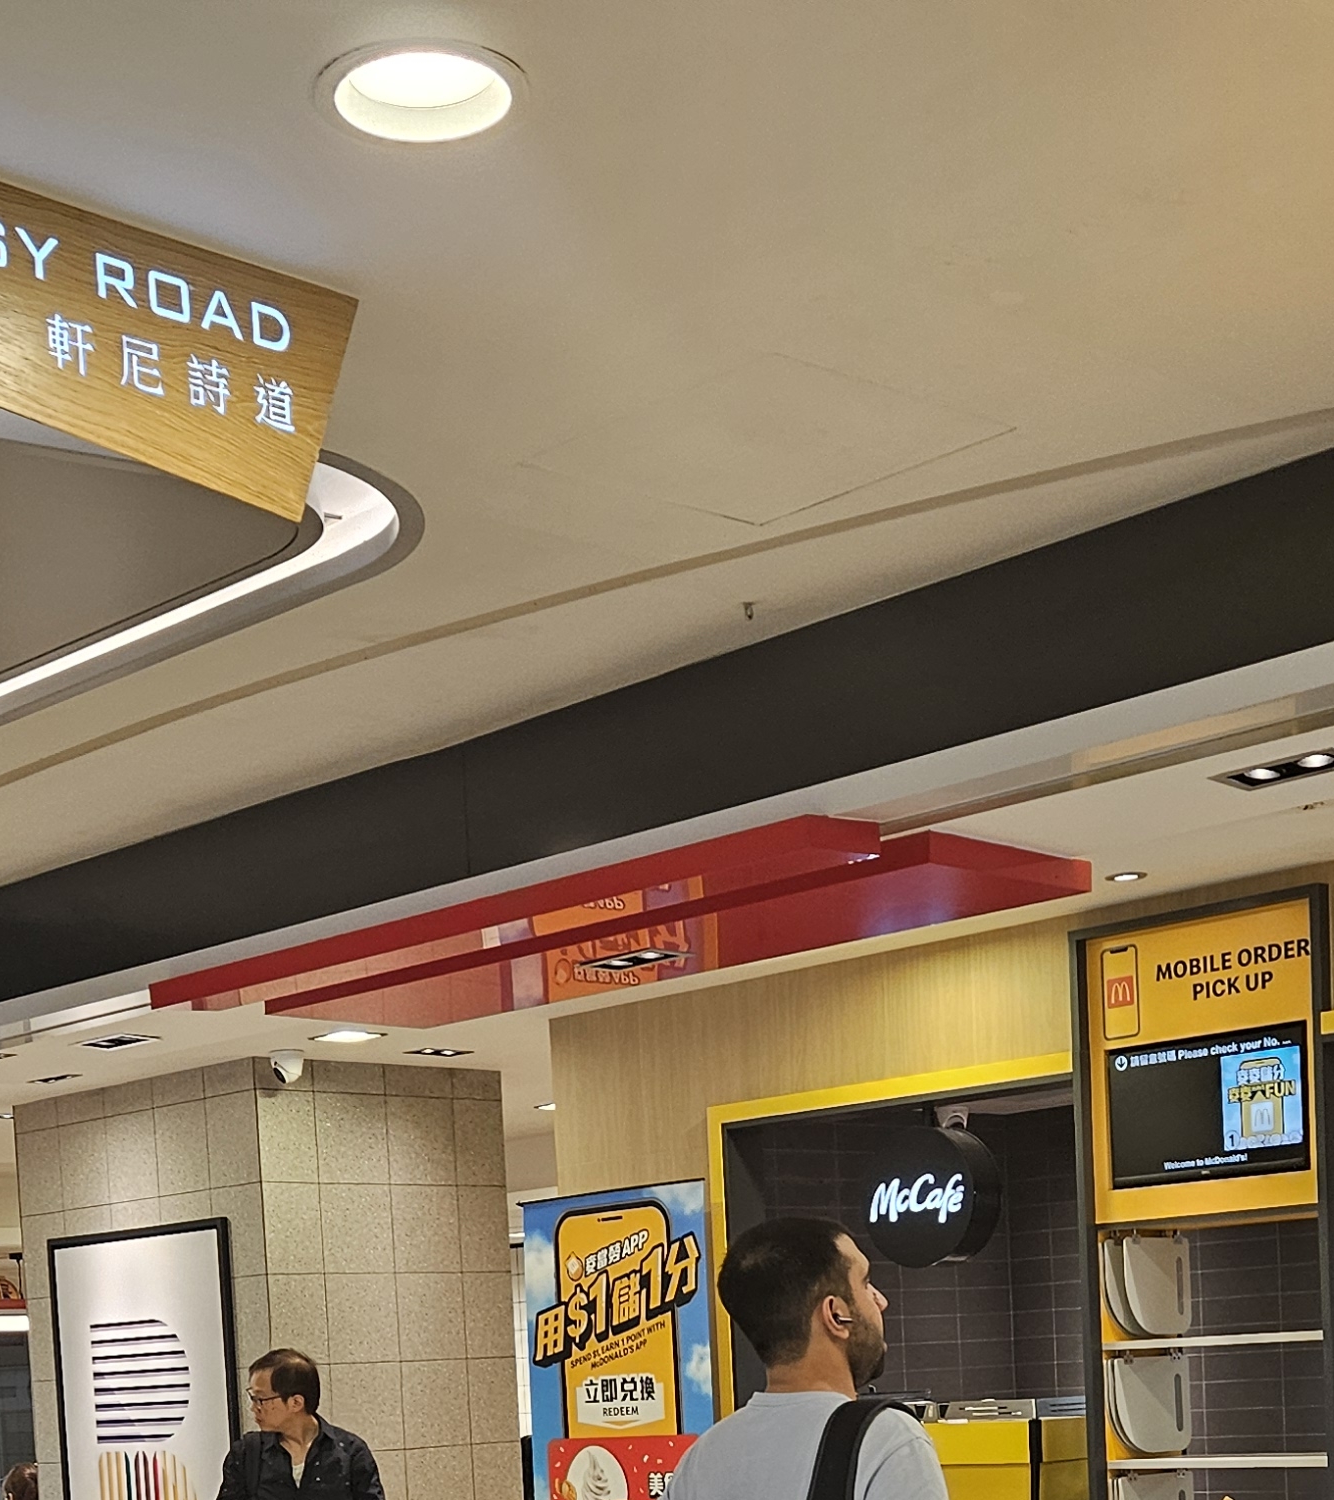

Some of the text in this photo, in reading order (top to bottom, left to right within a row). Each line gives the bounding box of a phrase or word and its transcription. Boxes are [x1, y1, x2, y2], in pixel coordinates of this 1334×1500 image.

[95, 251, 292, 353] ROAD
[46, 313, 297, 434] 軒尼詩道
[1156, 938, 1311, 982] MOBILE ORDER
[1193, 971, 1274, 1001] PICK UP
[1178, 1048, 1208, 1060] Please
[1210, 1042, 1238, 1055] check
[1239, 1040, 1262, 1053] your
[869, 1173, 965, 1223] McCafé
[570, 1352, 592, 1369] SPEND
[601, 1340, 620, 1355] EARN
[626, 1328, 645, 1345] POINT
[647, 1320, 666, 1335] WITH
[635, 1338, 648, 1352] APP
[603, 1406, 639, 1417] REDEEM
